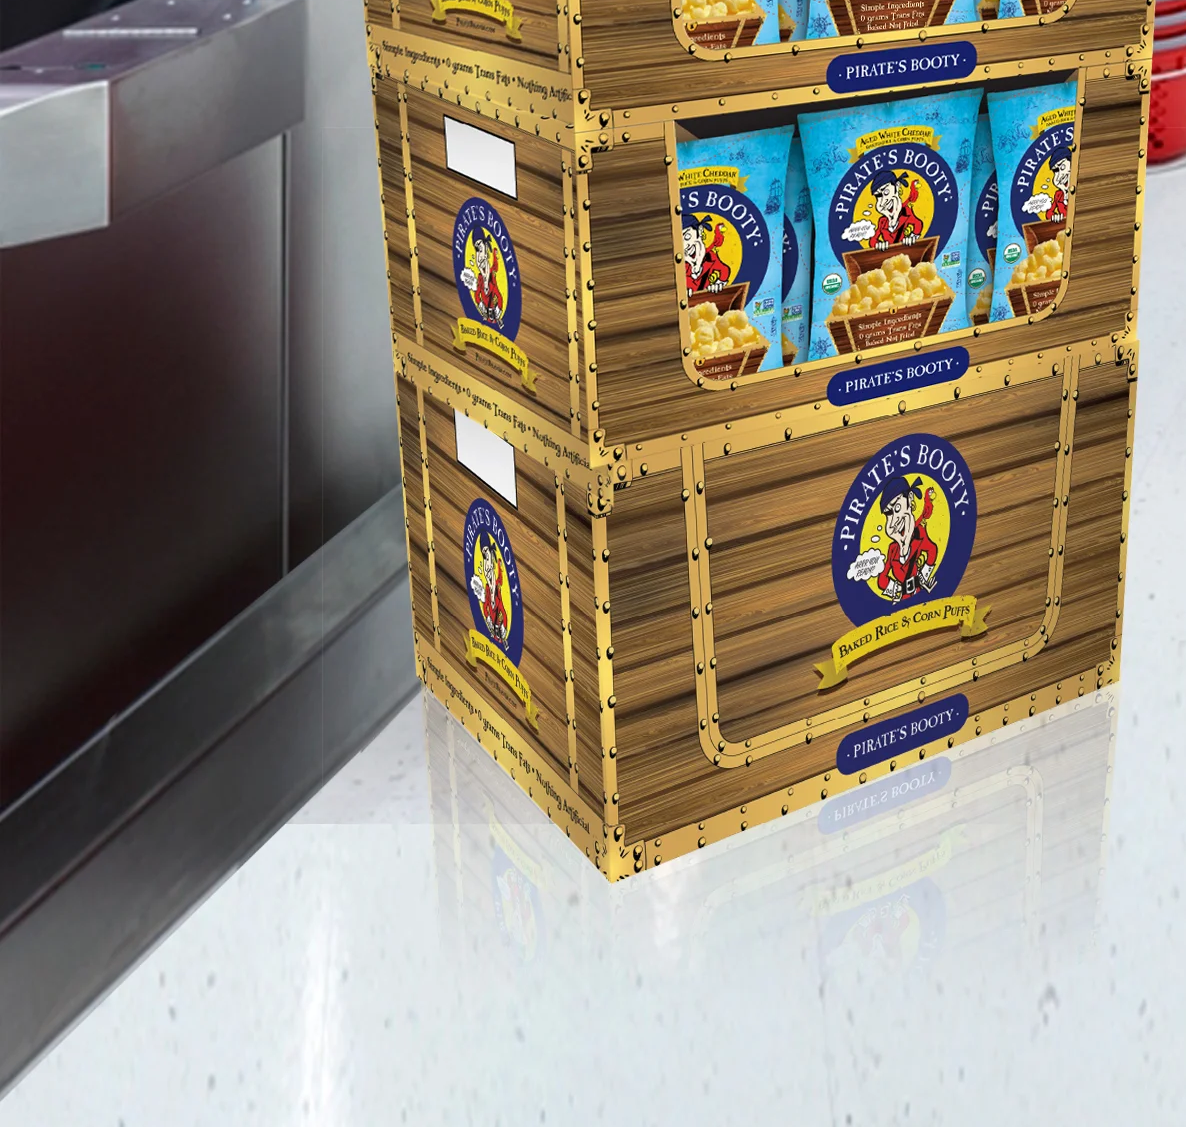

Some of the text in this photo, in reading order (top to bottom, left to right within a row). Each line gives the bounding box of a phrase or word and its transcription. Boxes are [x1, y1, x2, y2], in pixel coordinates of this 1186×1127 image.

[846, 53, 960, 80] PIRATE'S BOOTY
[835, 149, 952, 214] PIRATE'S BOOTY
[1017, 127, 1074, 187] PIRATE'S
[487, 210, 517, 278] BOOTY
[705, 191, 761, 241] BOOTY
[845, 358, 953, 393] PIRATE'S BOOTY
[840, 443, 970, 541] PIRATE'S BOOTY
[492, 515, 520, 601] BOOTY
[838, 604, 970, 659] BAKED RICE & CORN PUFFS
[853, 709, 954, 758] PIRATE'S BOOTY
